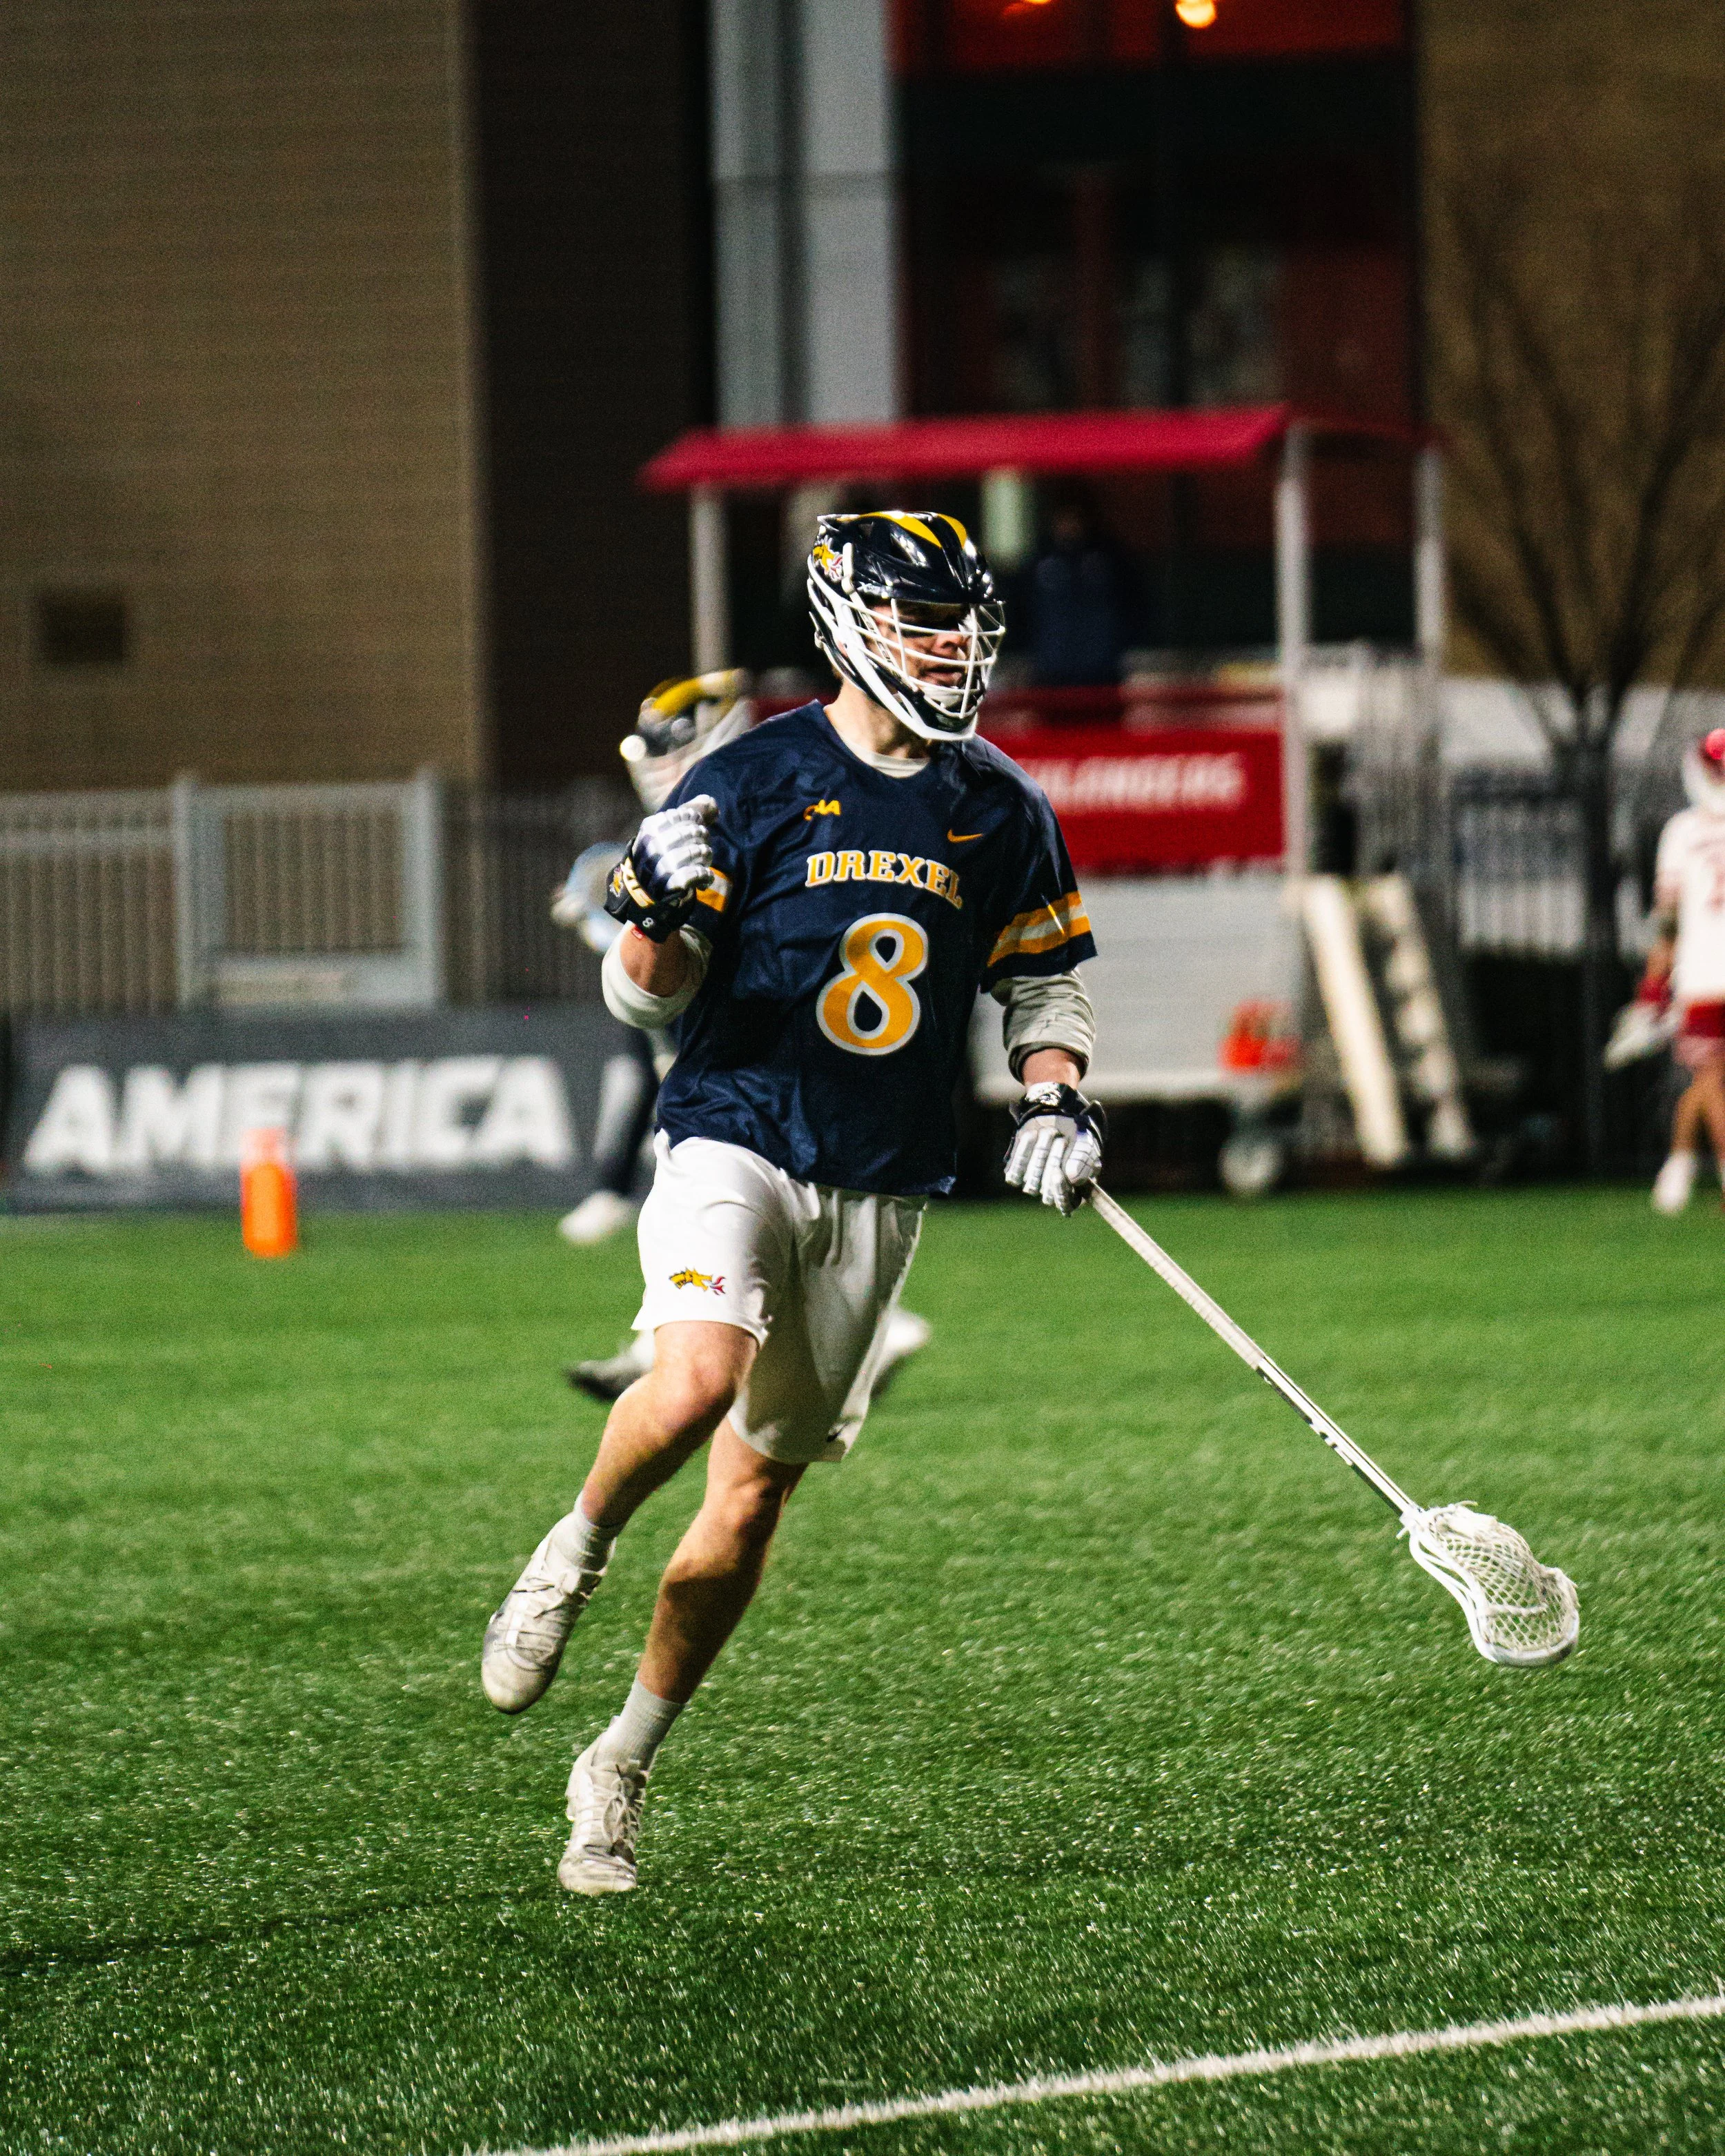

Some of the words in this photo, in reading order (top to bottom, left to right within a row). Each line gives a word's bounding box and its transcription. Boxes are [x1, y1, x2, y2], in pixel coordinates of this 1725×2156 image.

[805, 850, 963, 909] DREXEL
[816, 912, 929, 1056] 8
[25, 1056, 575, 1172] AMERICA
